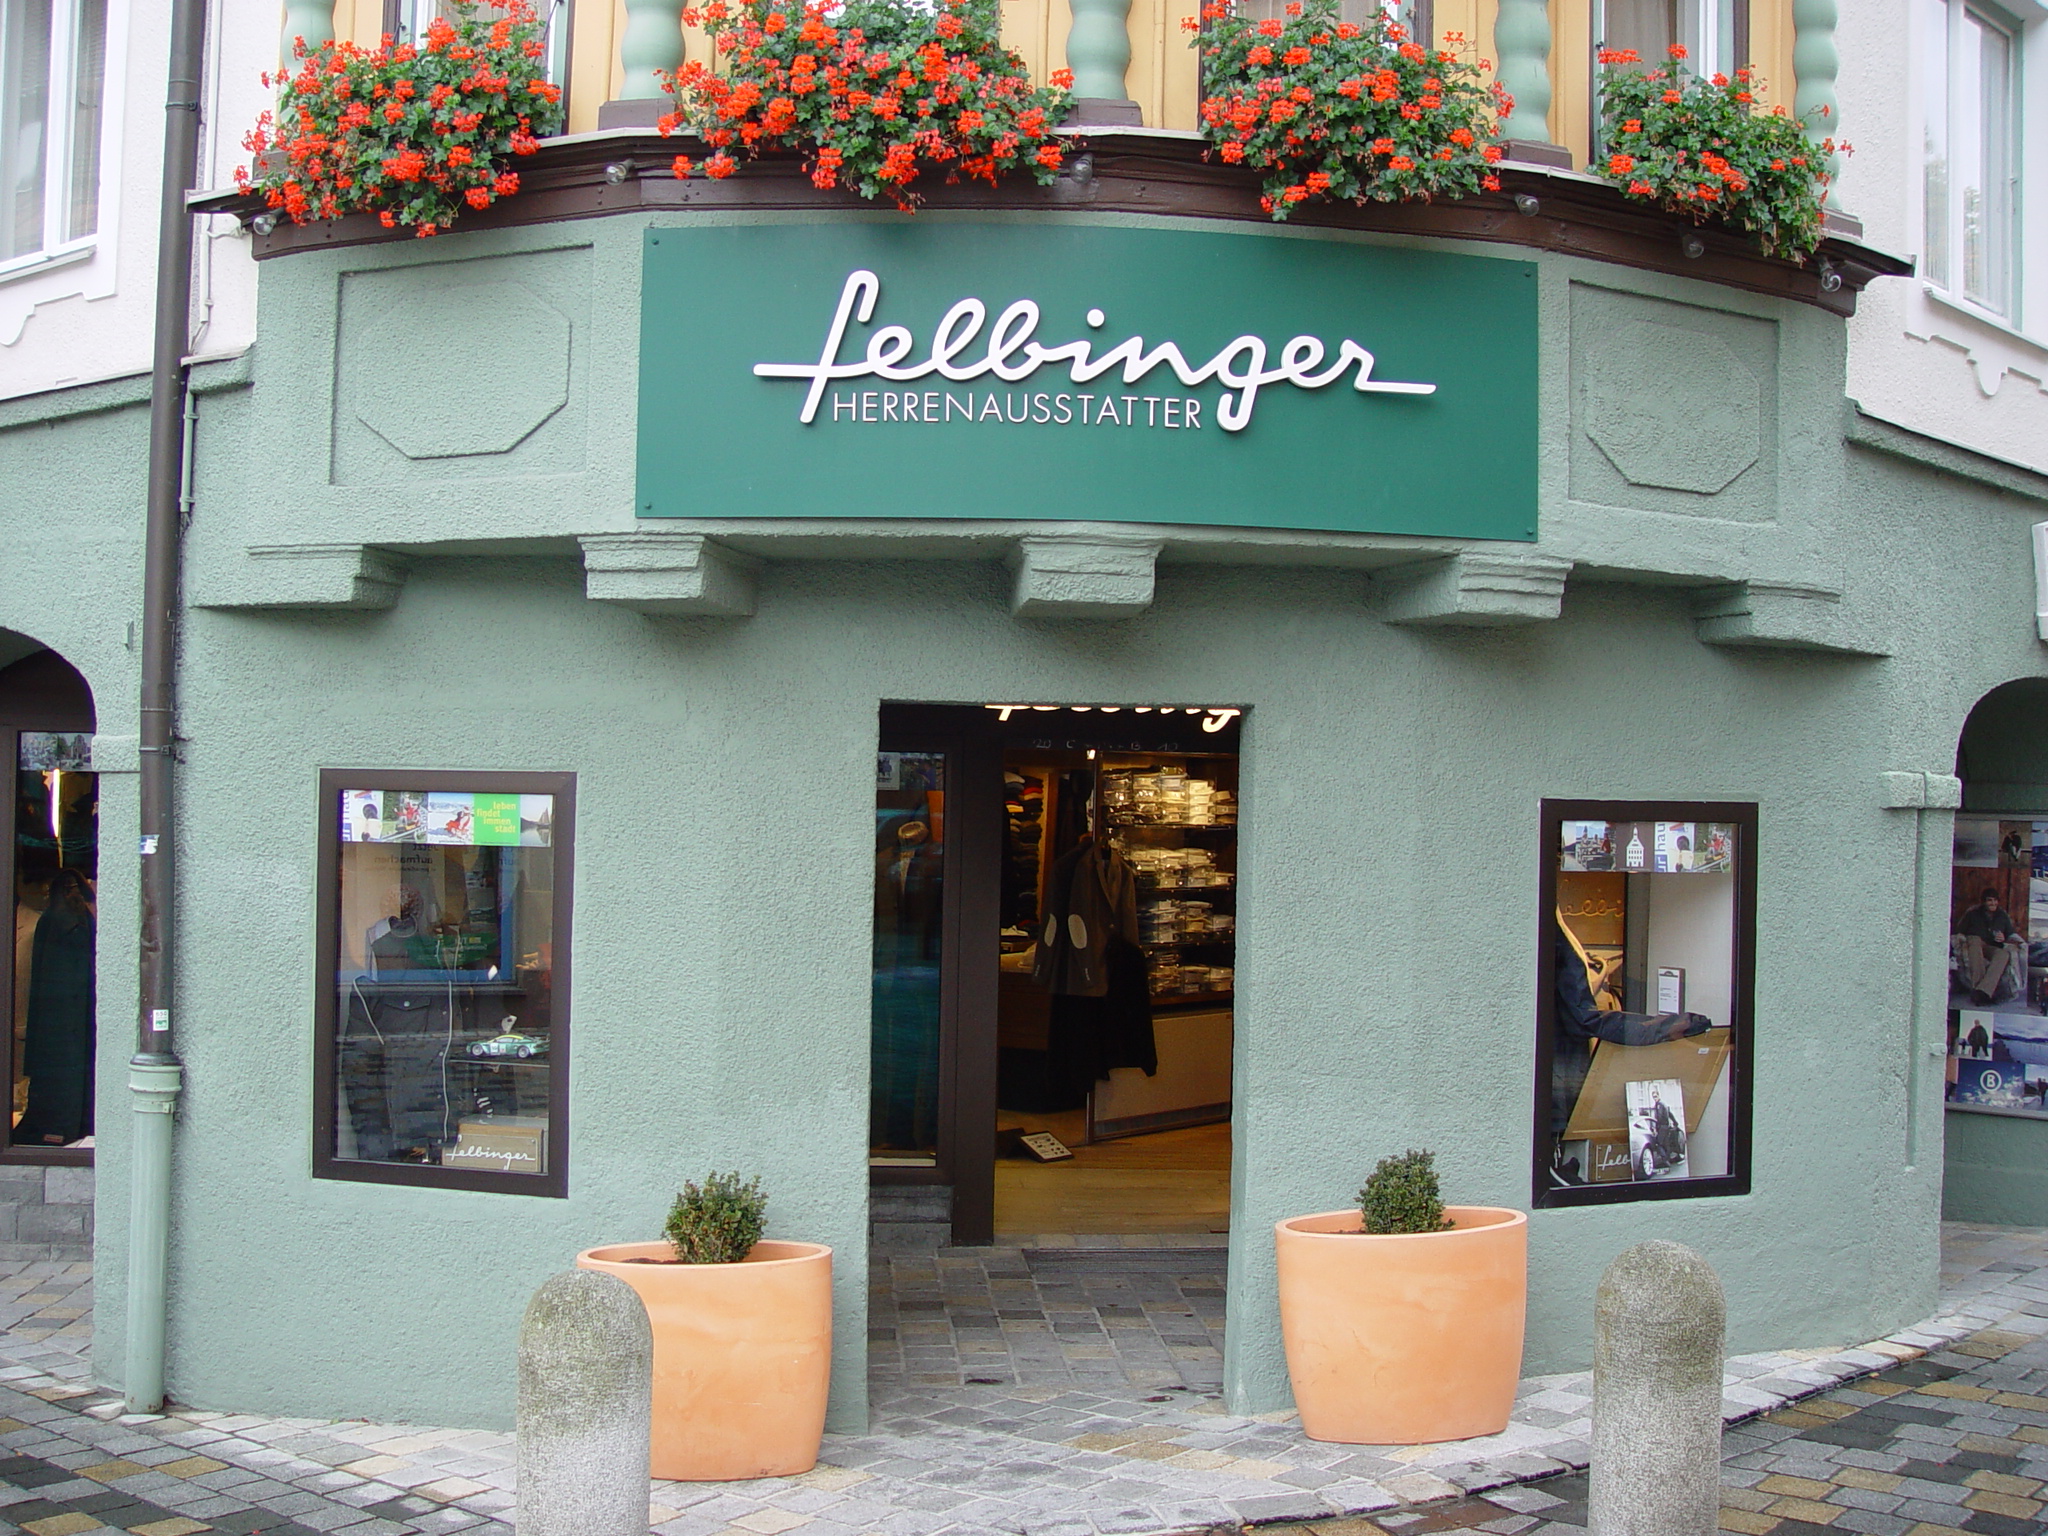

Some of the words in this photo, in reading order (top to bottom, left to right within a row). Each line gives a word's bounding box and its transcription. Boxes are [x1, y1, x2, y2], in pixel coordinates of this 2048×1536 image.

[753, 269, 1437, 432] felbinger
[833, 392, 1202, 429] HERRENAUSSTATTER
[476, 808, 501, 817] findet
[493, 801, 517, 810] leben
[494, 825, 516, 833] stadt
[445, 1134, 536, 1171] felbinger
